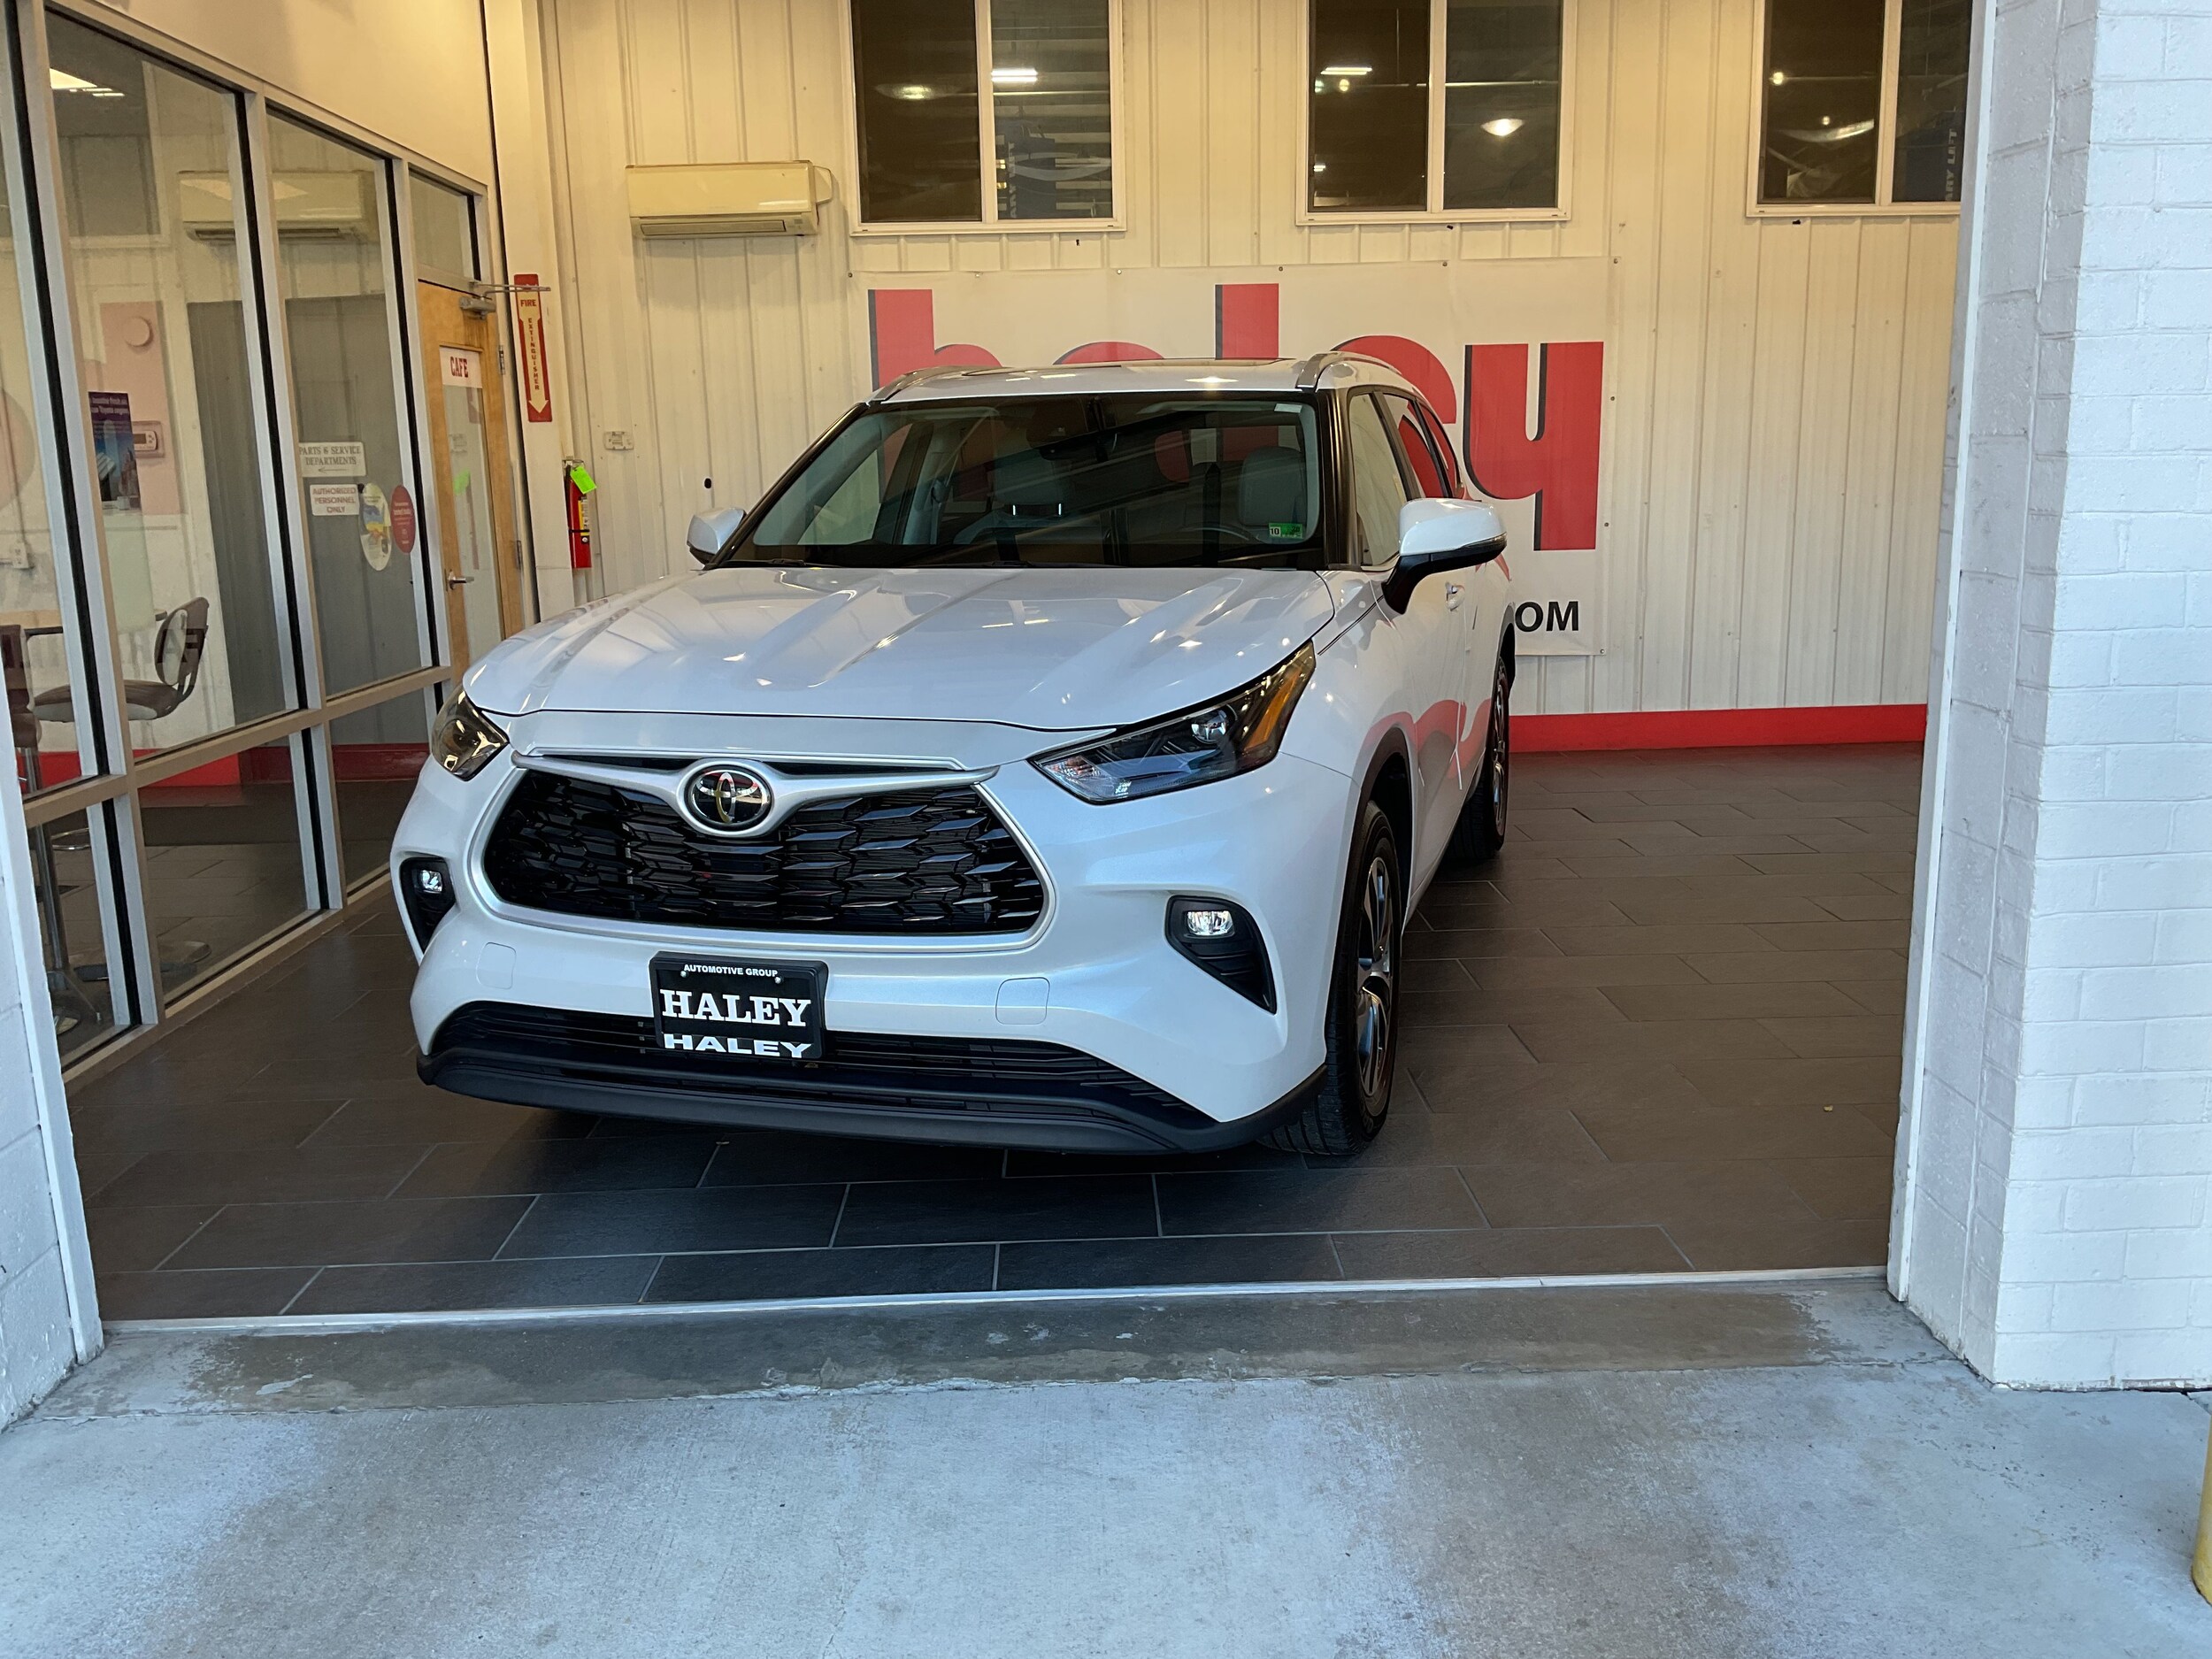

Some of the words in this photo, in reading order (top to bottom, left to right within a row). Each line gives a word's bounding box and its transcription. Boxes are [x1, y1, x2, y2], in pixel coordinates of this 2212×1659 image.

[528, 318, 540, 390] EXTINGUISHER
[449, 356, 469, 378] CAFE
[298, 447, 321, 456] PARTS
[331, 446, 361, 455] SERVICE
[305, 457, 357, 465] DEPARTMENTS
[684, 964, 743, 975] AUTOMOTIVE
[746, 968, 779, 978] GROUP
[659, 988, 811, 1027] HALEY
[664, 1033, 811, 1058] HALEY
